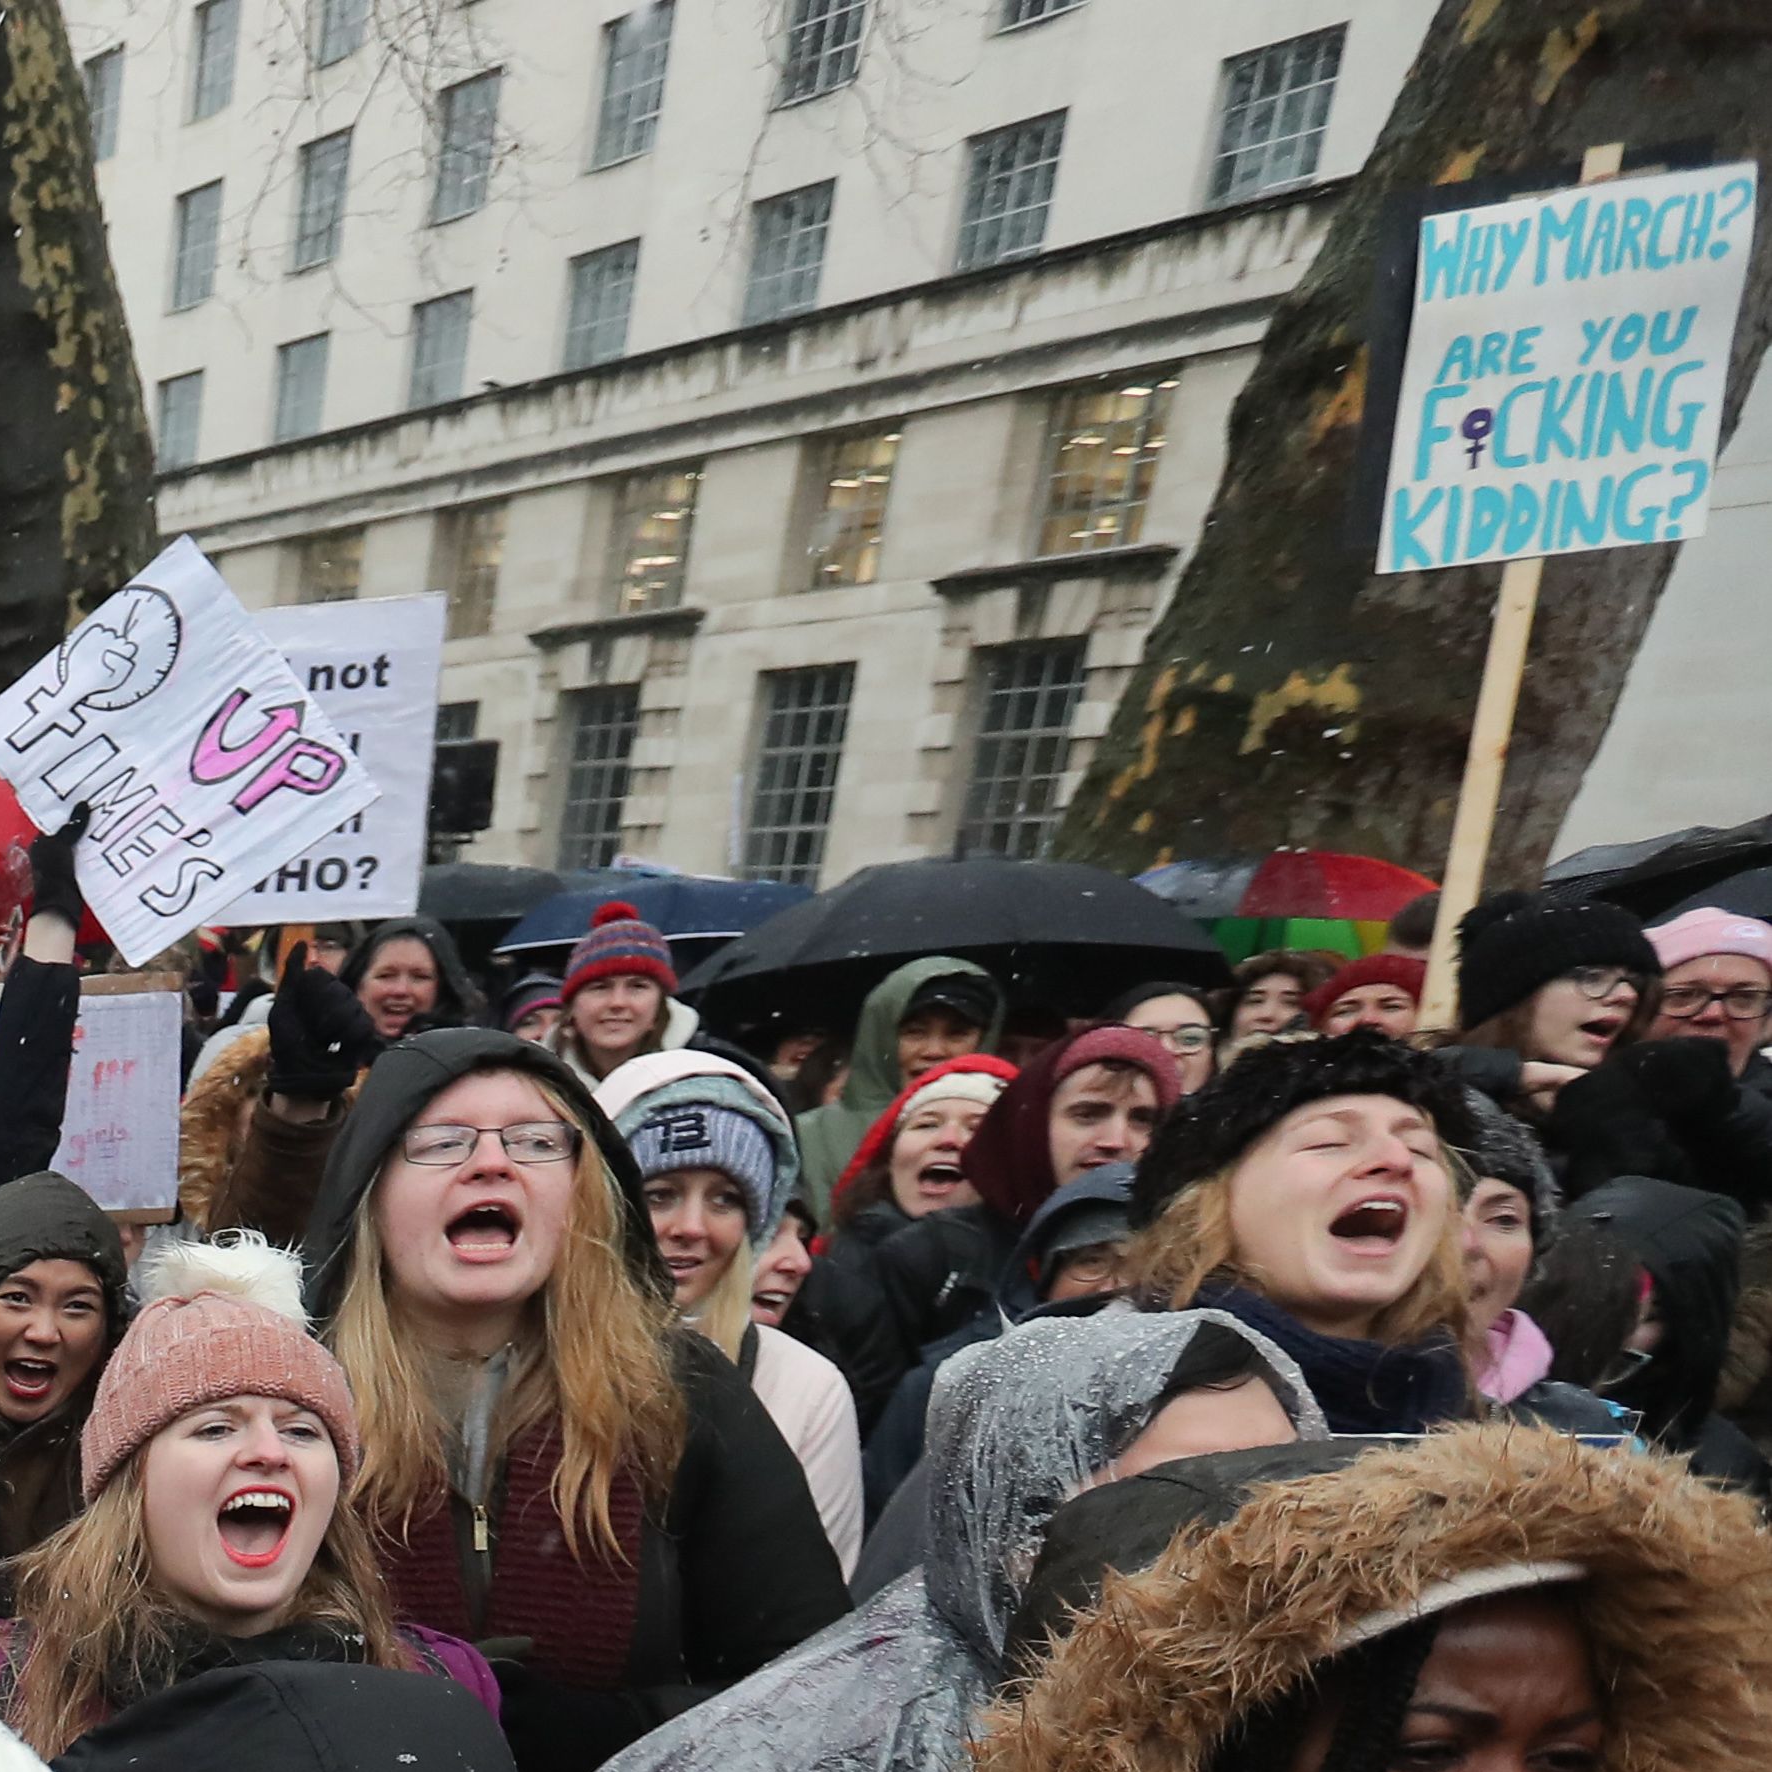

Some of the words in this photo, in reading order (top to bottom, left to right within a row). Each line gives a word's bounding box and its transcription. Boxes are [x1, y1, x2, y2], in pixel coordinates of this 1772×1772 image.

[1420, 212, 1532, 303] WHY
[1534, 177, 1753, 286] MARCH?
[1434, 324, 1543, 386] ARE
[1579, 305, 1700, 366] YOU
[1389, 458, 1709, 572] KIDDING?
[307, 653, 391, 692] not
[189, 686, 346, 814] UP
